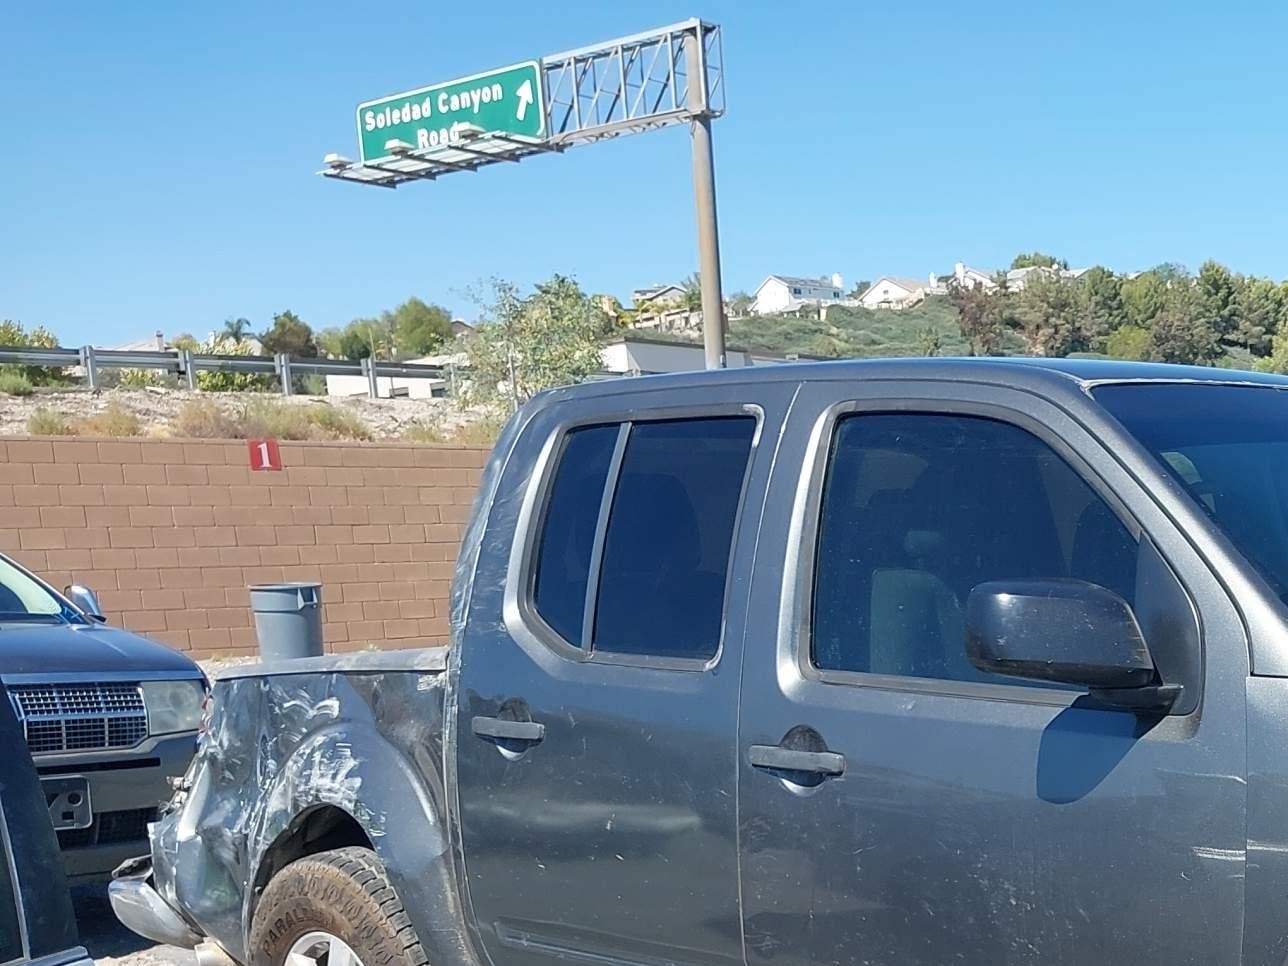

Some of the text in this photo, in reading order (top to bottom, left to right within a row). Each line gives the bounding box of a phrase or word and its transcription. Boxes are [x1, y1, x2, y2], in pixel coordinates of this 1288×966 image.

[365, 83, 503, 132] Soledad Canyon
[417, 121, 459, 150] Road
[257, 442, 273, 468] 1
